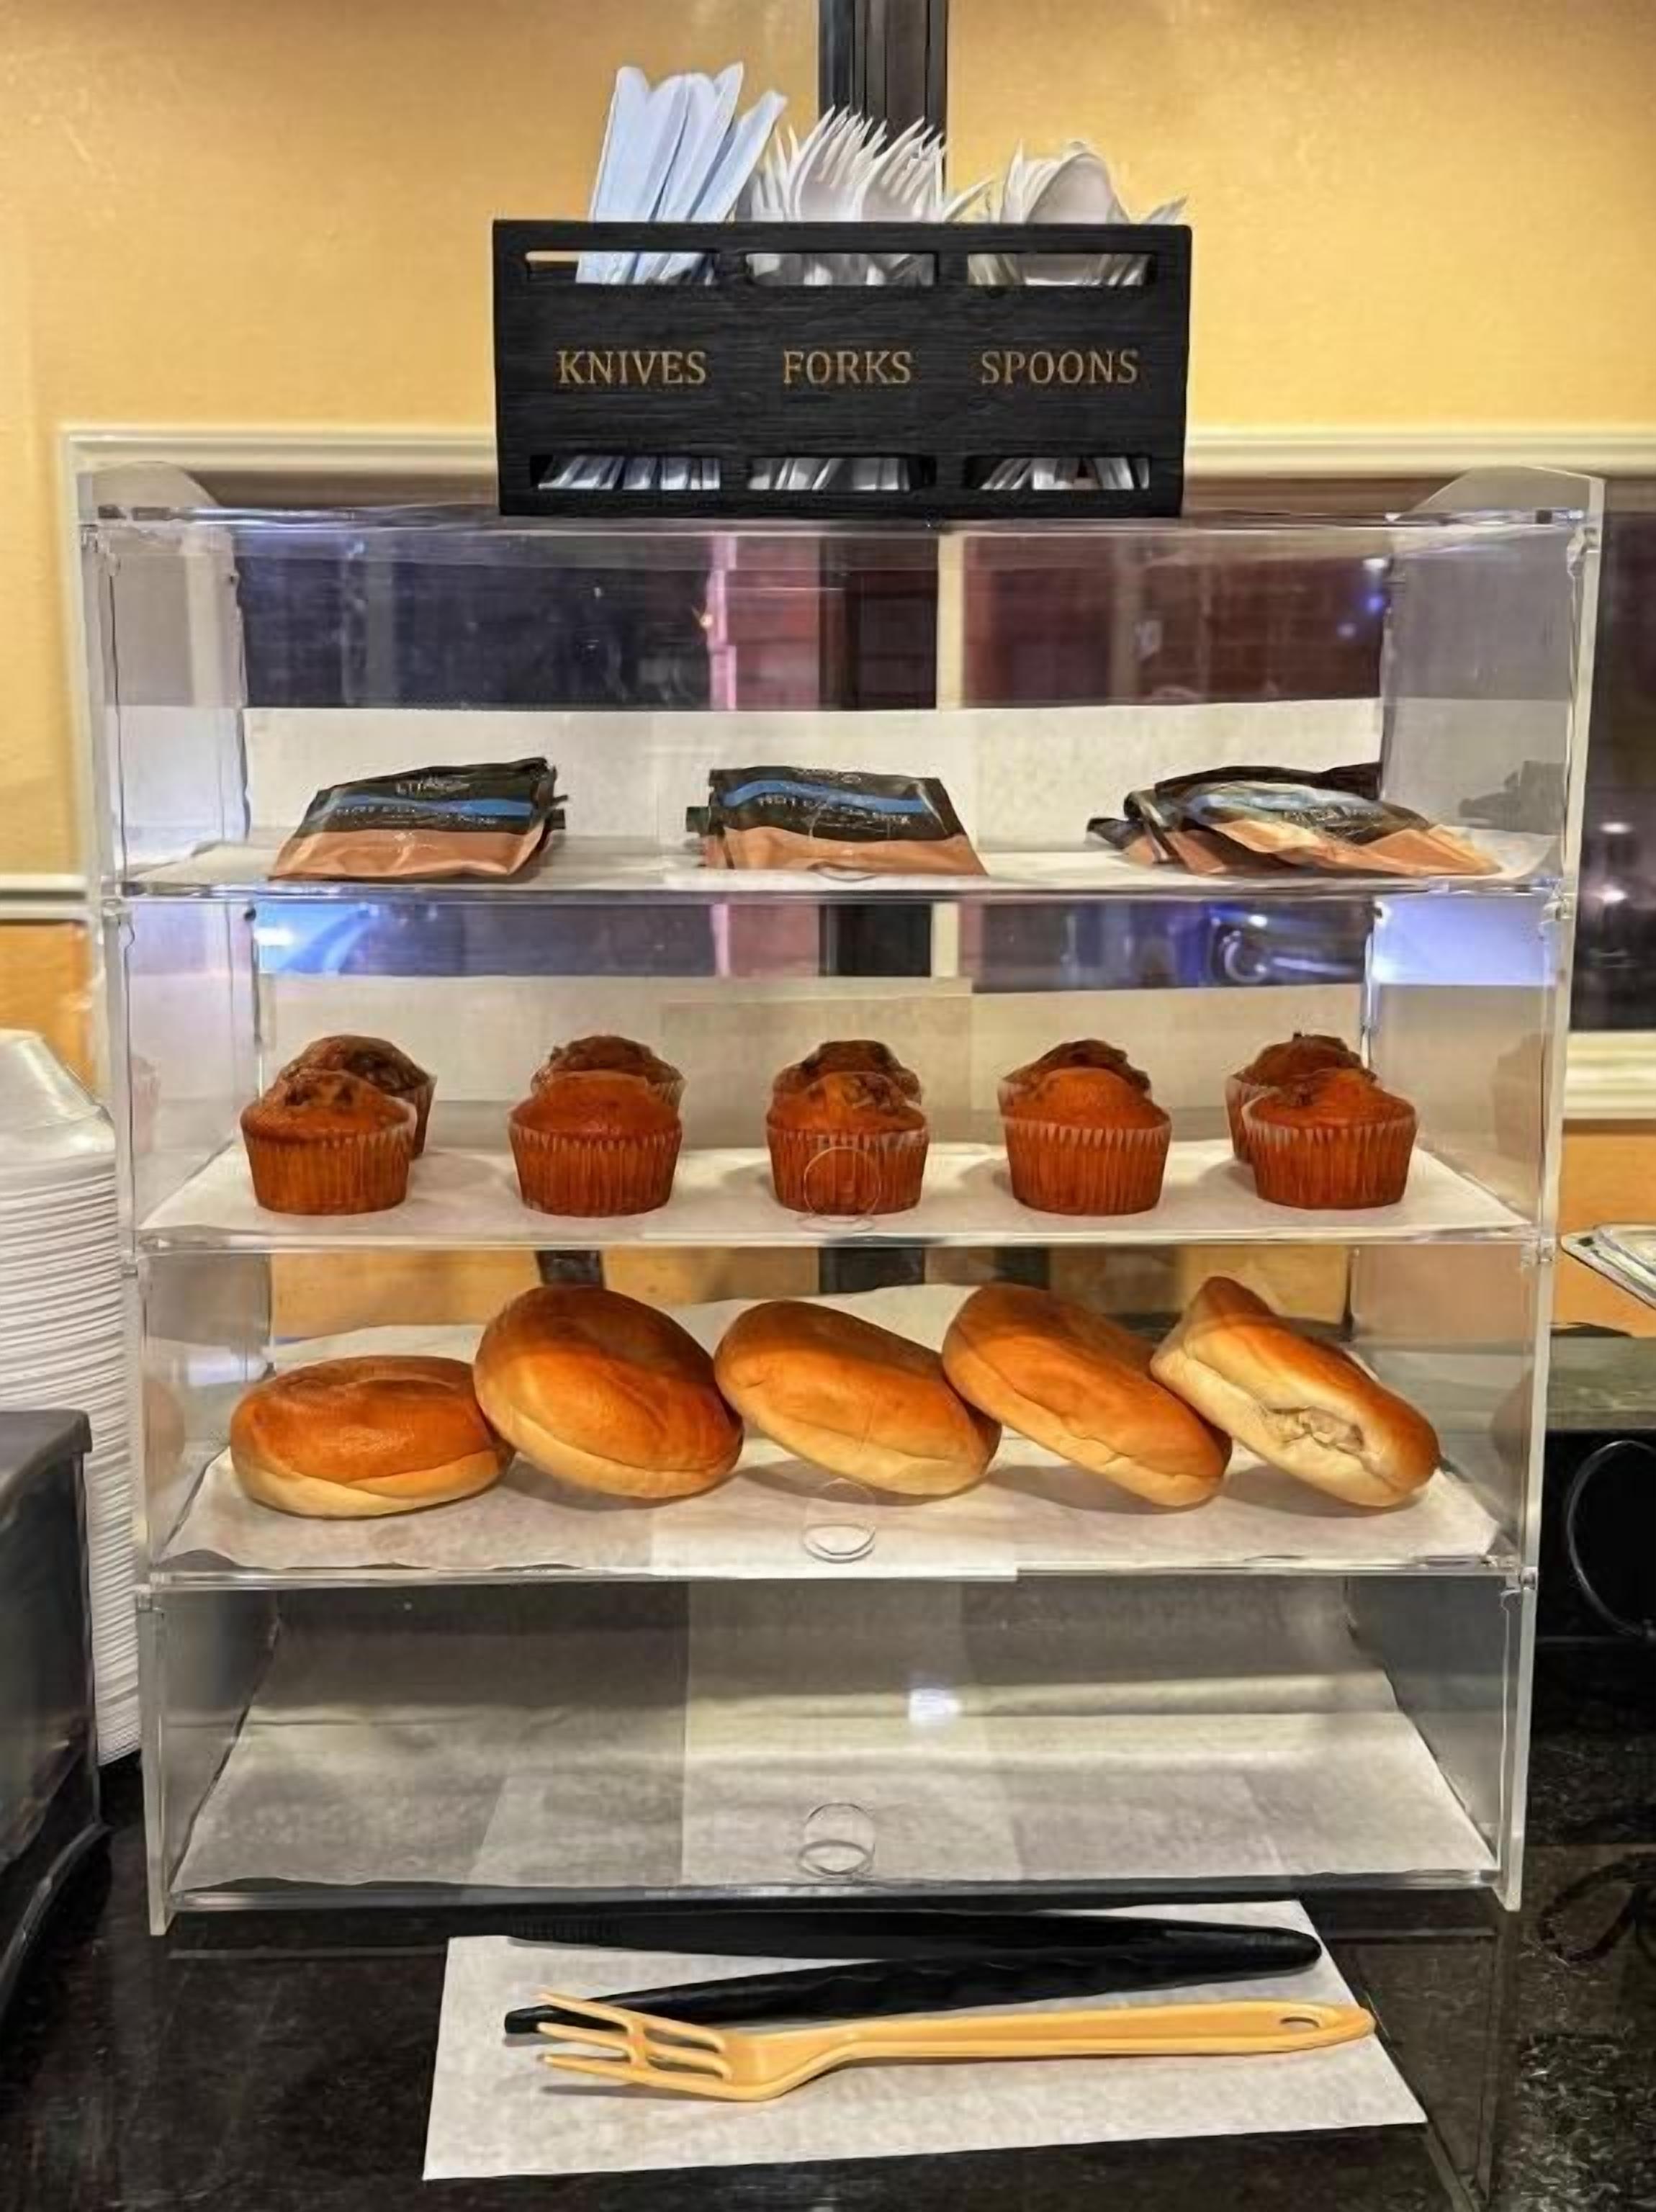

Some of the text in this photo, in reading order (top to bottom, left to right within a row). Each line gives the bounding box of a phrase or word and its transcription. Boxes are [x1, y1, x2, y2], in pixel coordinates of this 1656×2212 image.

[557, 349, 707, 385] KNIVES
[783, 349, 912, 385] FORKS
[981, 350, 1138, 385] SPOONS
